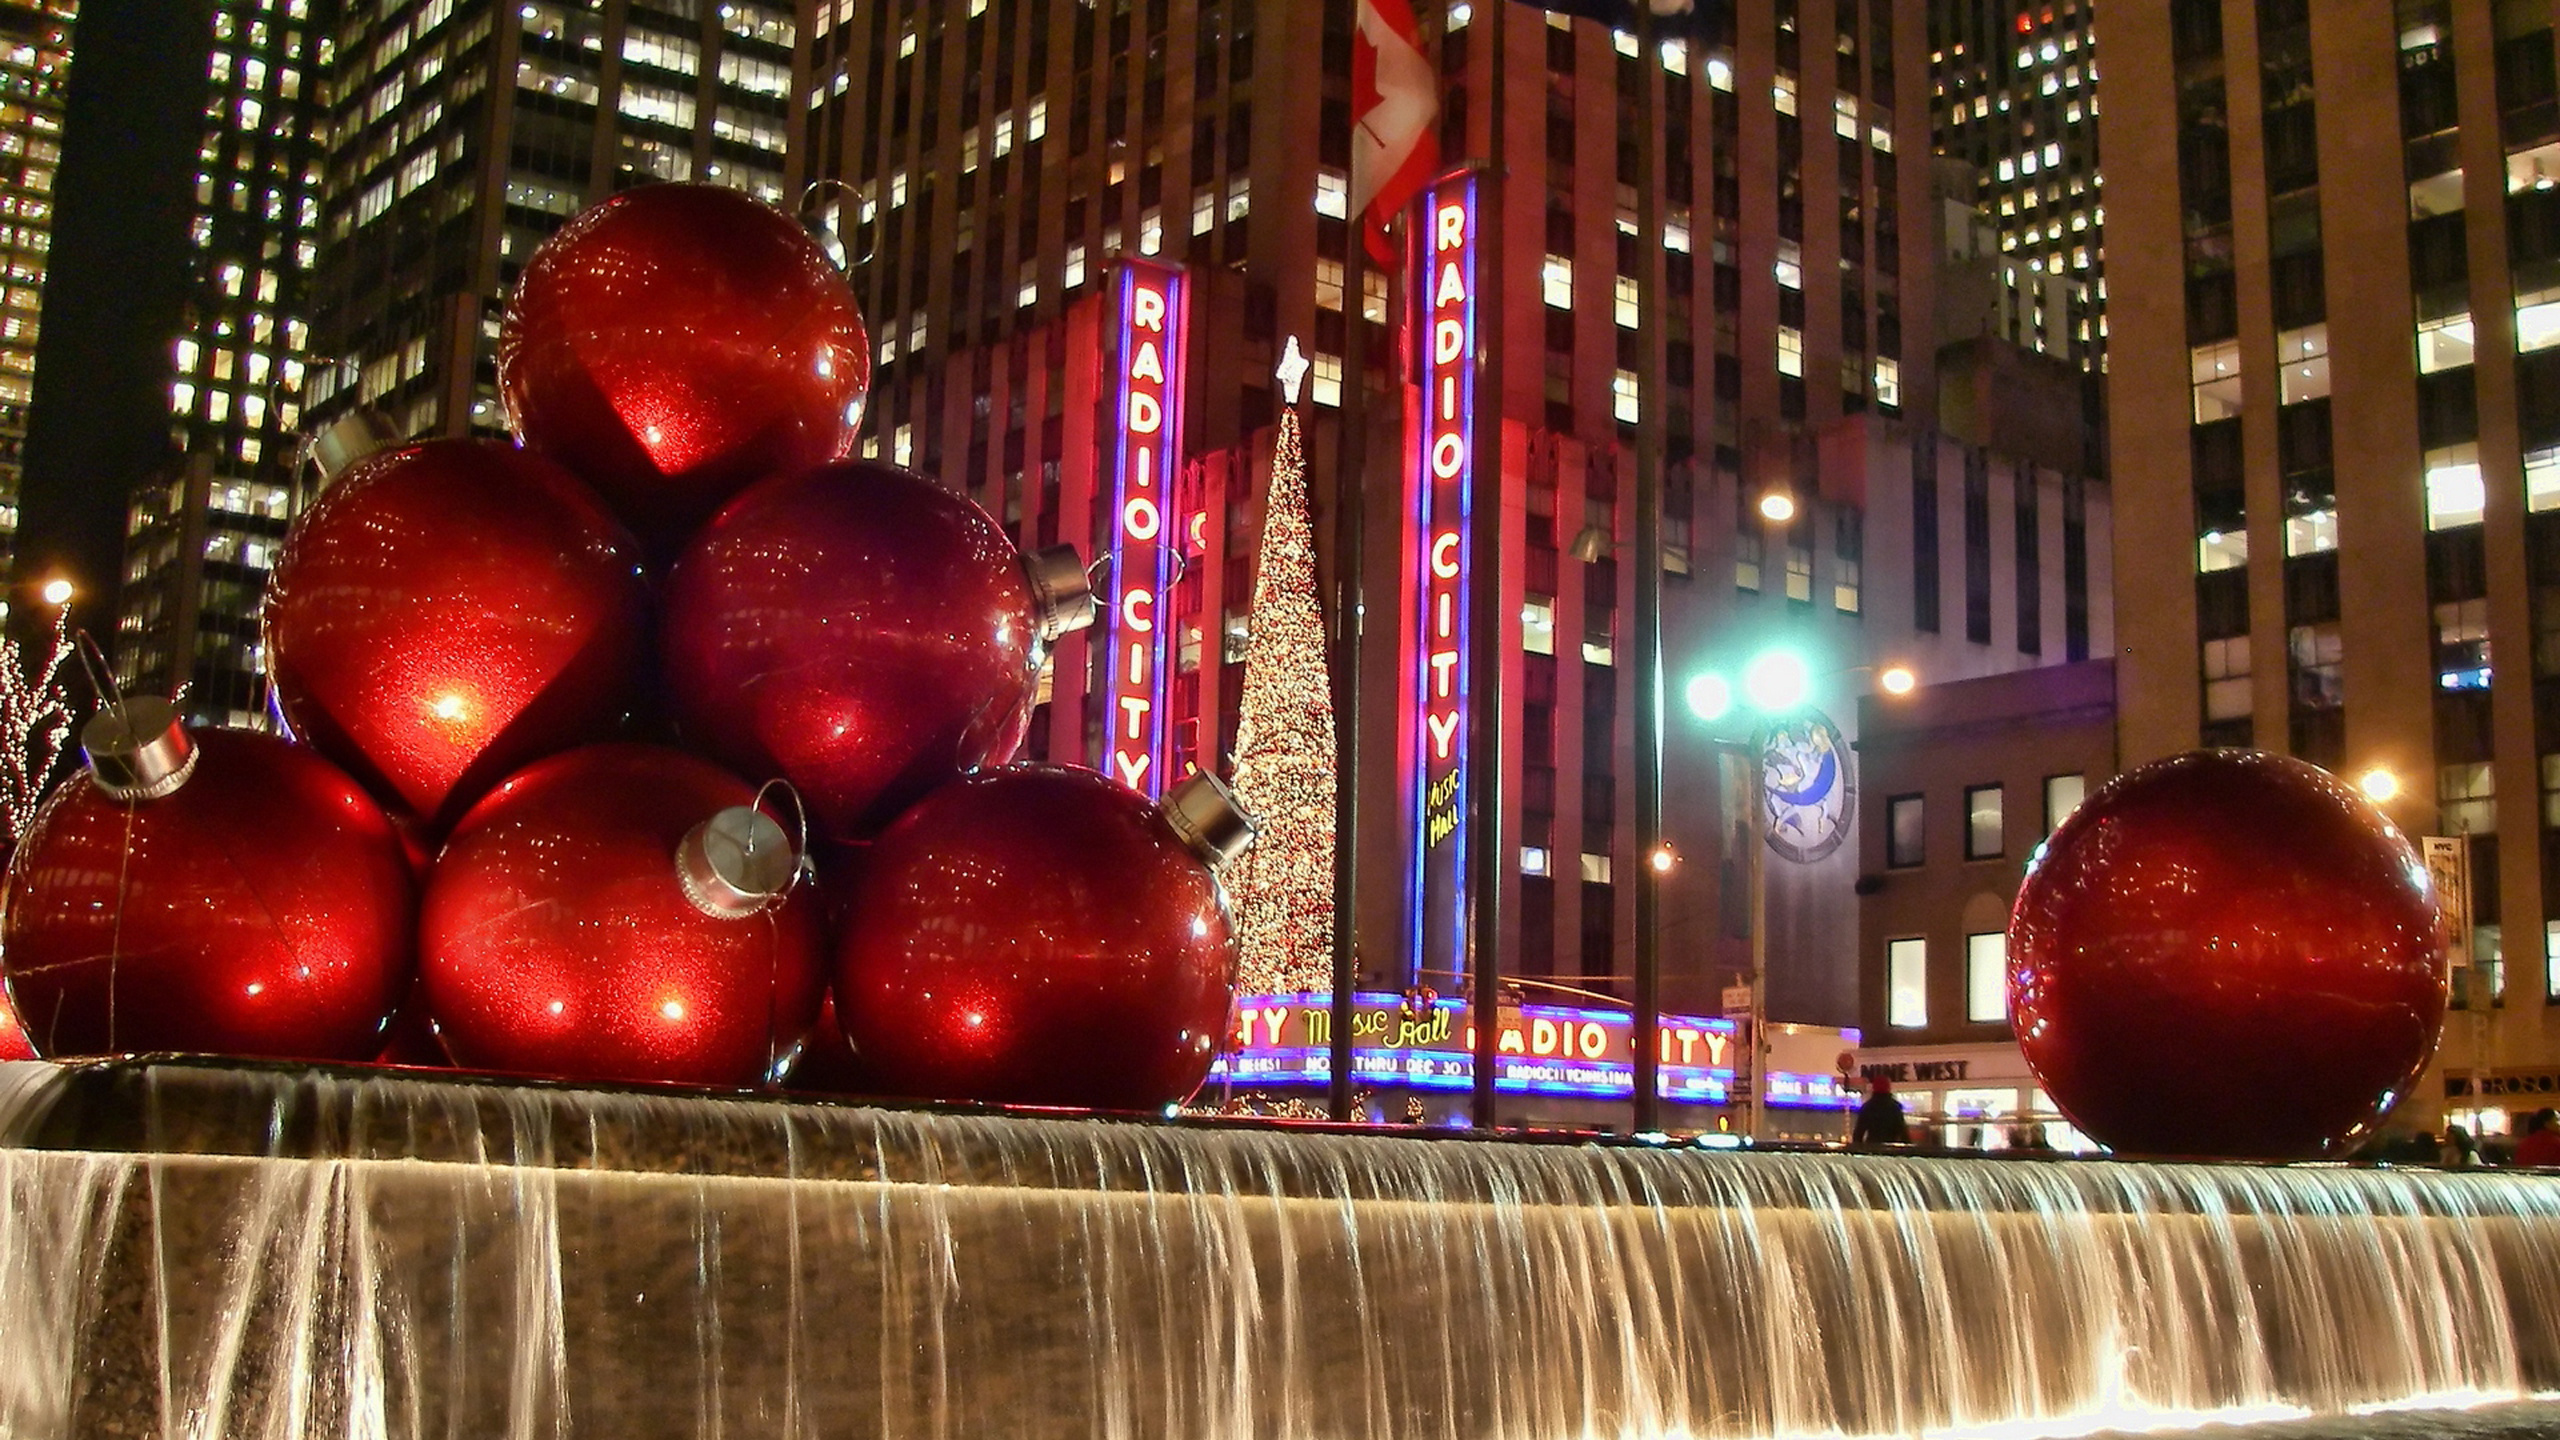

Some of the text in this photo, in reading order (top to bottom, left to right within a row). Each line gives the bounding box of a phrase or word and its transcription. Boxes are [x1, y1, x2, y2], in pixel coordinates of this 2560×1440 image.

[1427, 205, 1466, 759] RADIO CITY
[1115, 287, 1165, 790] RADIO CITY
[2433, 843, 2453, 851] NYC
[1302, 1009, 1388, 1046] Msic
[1466, 1018, 1608, 1059] ADIO
[1631, 1027, 1727, 1065] ITY
[1305, 1056, 1331, 1072] NO
[1355, 1056, 1398, 1073] THRU
[1406, 1058, 1435, 1075] DEC
[1442, 1061, 1463, 1076] 30
[1860, 1060, 1969, 1082] NINE WEST
